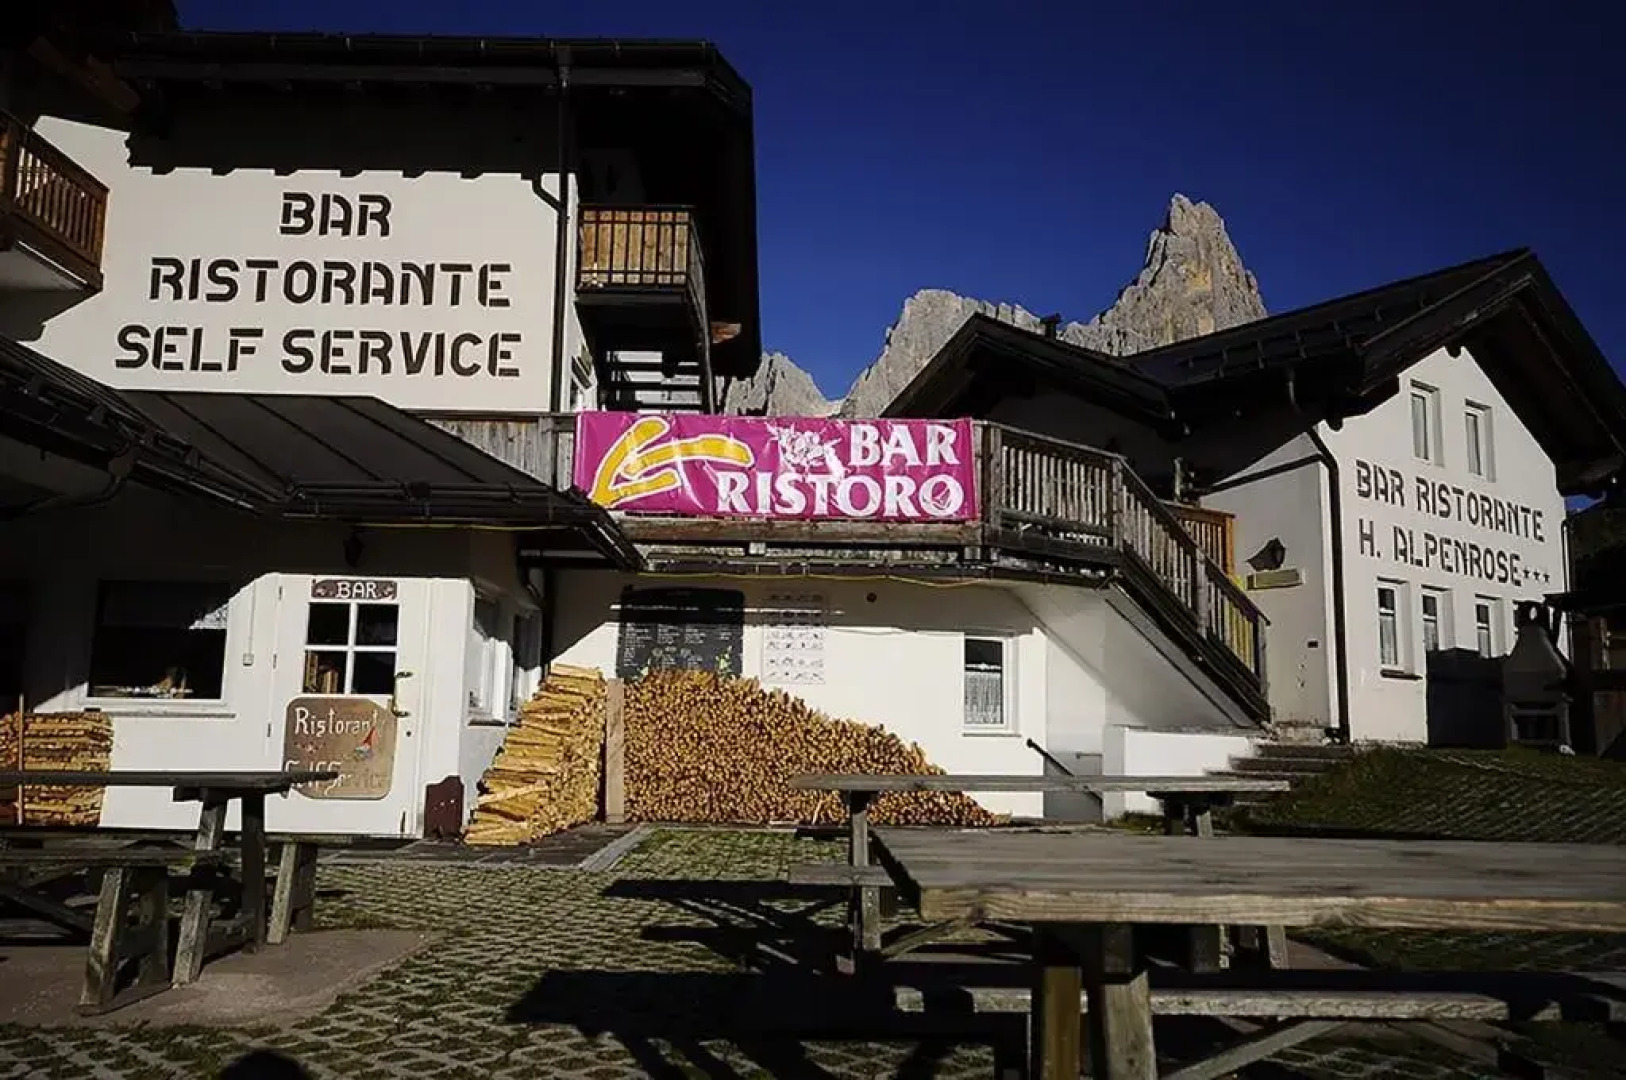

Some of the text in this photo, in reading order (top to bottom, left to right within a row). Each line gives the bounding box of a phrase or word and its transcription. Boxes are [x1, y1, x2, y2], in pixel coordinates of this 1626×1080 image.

[279, 191, 392, 238] BAR
[149, 256, 511, 307] RISTORANTE
[115, 324, 522, 377] SELF SERVICE
[849, 423, 960, 466] BAR
[715, 471, 964, 517] RISTORO
[1355, 459, 1545, 543] BAR RISTORANTE
[1358, 518, 1522, 586] H. ALPENROSE
[335, 582, 378, 600] BAR
